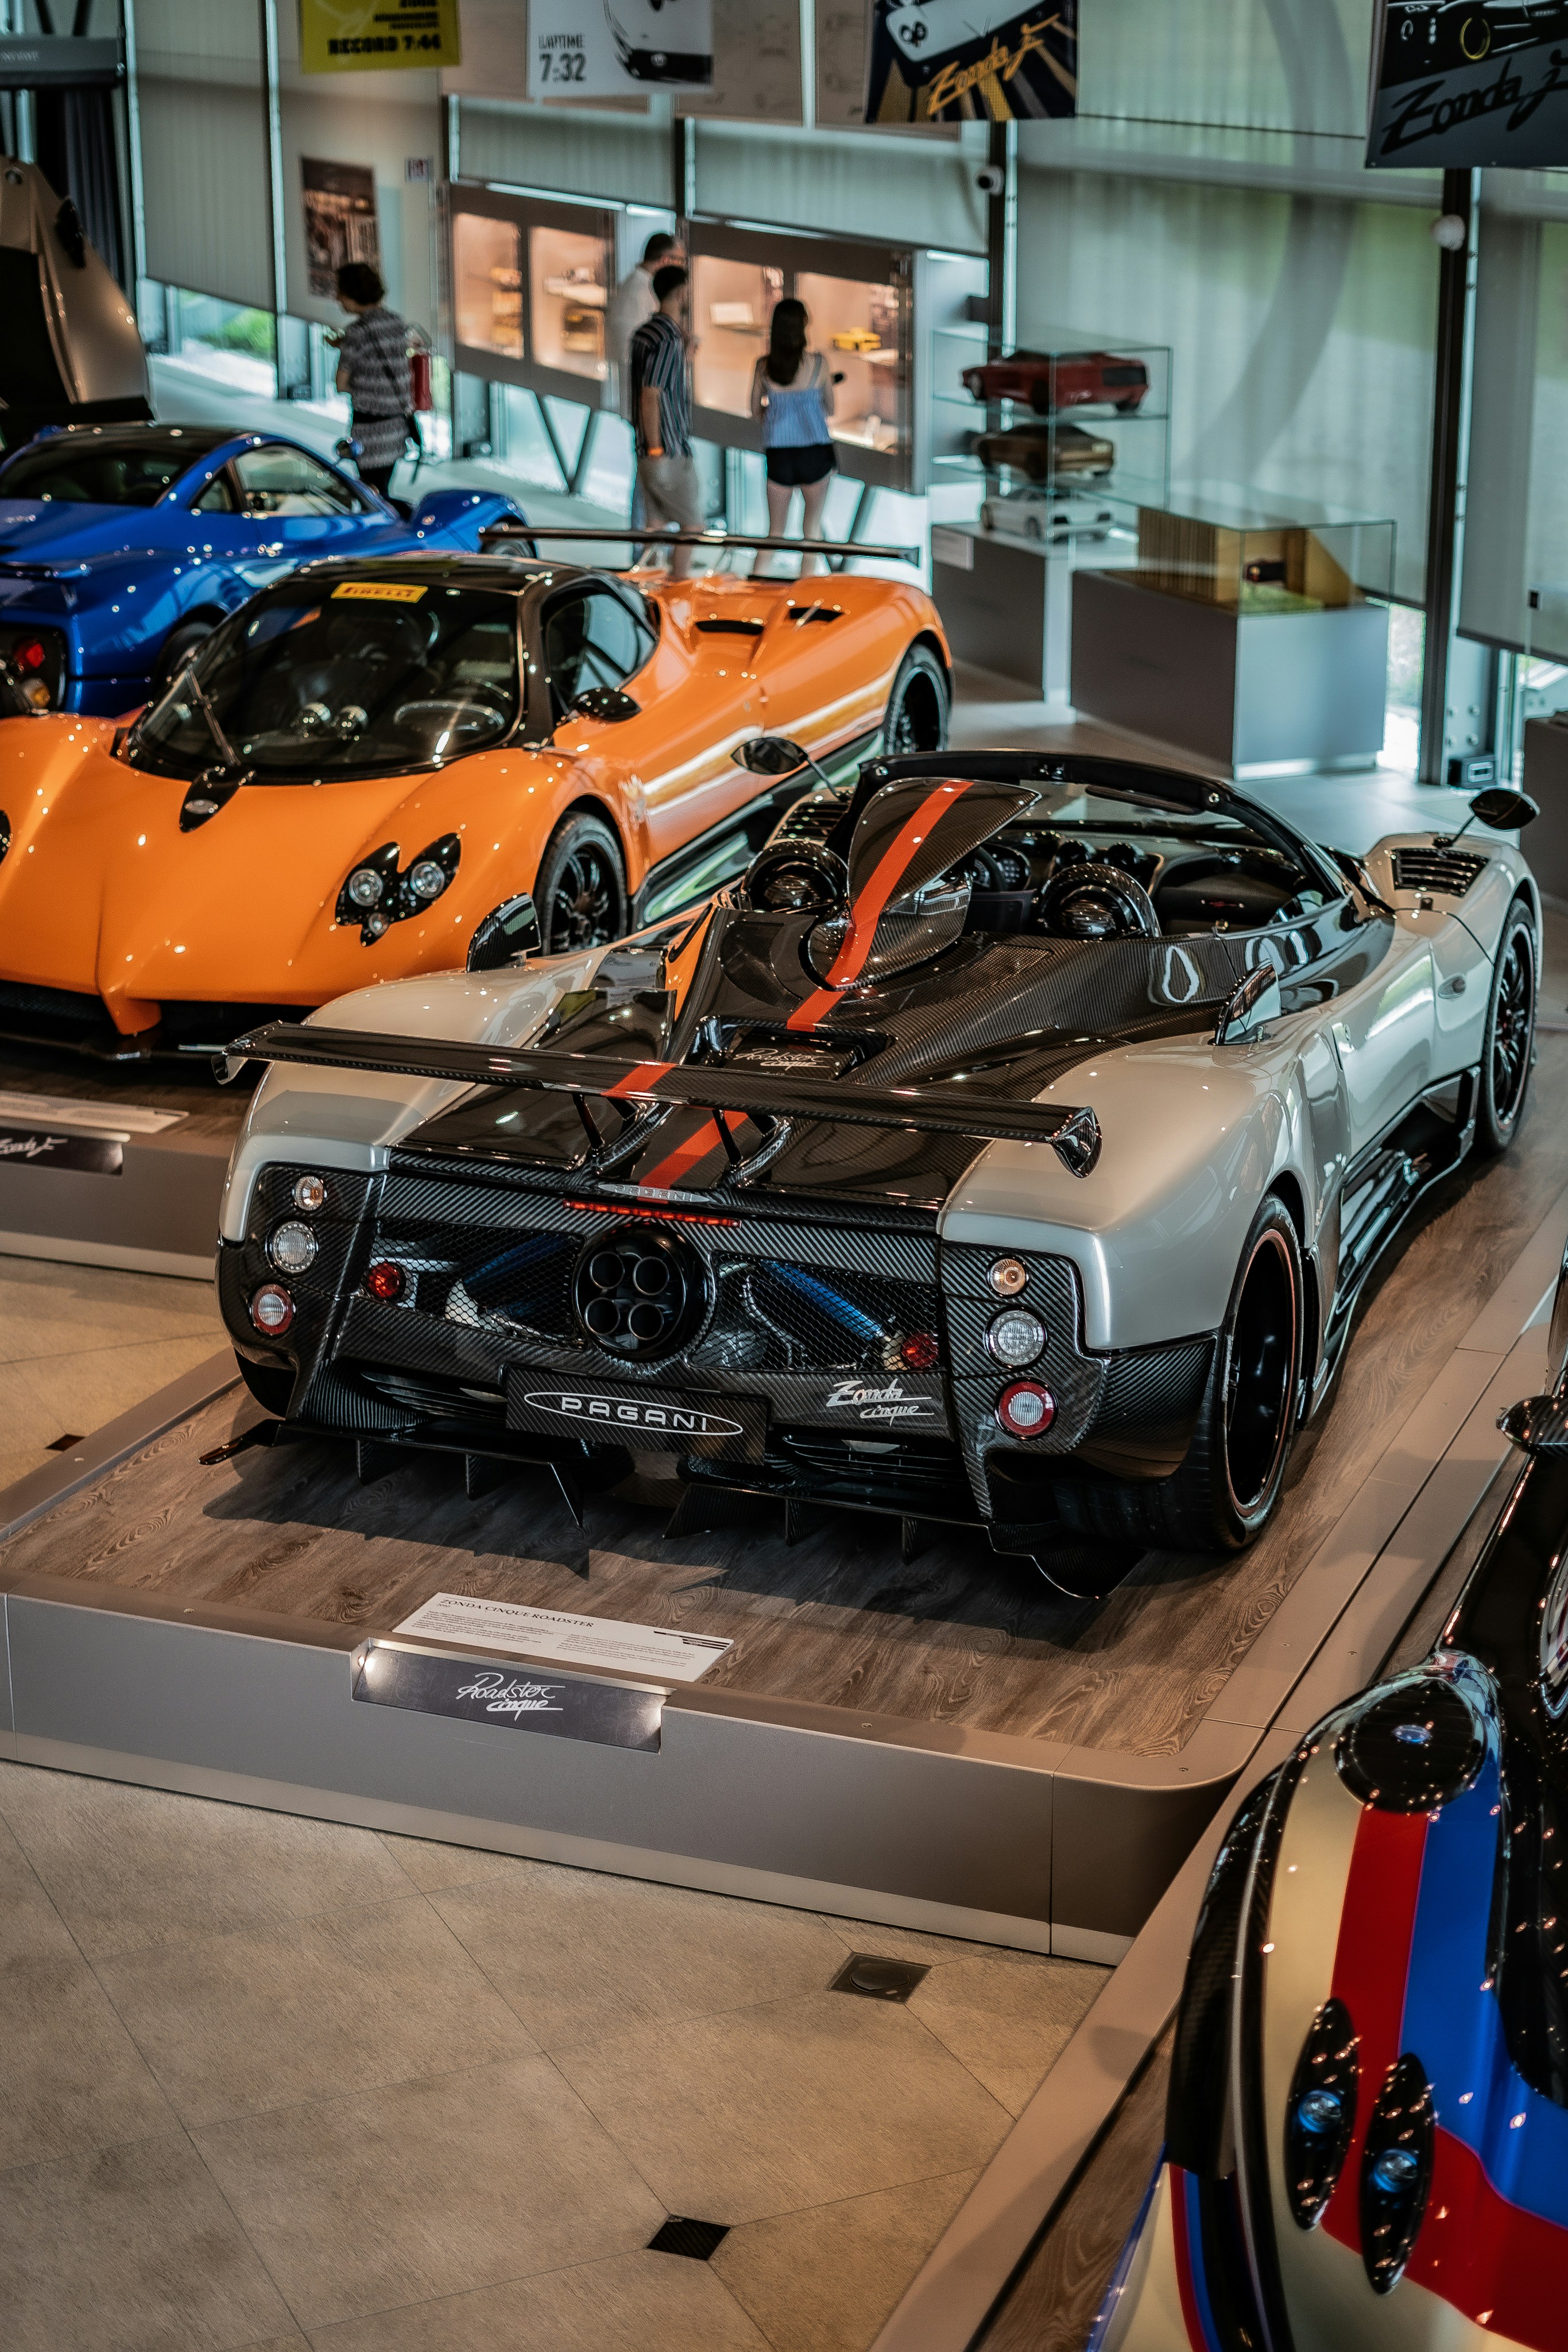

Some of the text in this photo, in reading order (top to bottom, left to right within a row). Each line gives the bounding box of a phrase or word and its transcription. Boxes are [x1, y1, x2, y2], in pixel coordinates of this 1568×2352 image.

[328, 36, 397, 55] RECORD
[539, 52, 587, 82] 7:32
[1380, 56, 1524, 156] Zonda
[614, 1184, 693, 1202] PAGANI
[826, 1378, 932, 1407] Zonda
[562, 1396, 707, 1431] PAGANI
[860, 1405, 935, 1427] cinque
[440, 1599, 594, 1627] ZONDA CINQUE ROADSTER
[455, 1672, 566, 1700] Roadster
[486, 1697, 564, 1722] cinque
